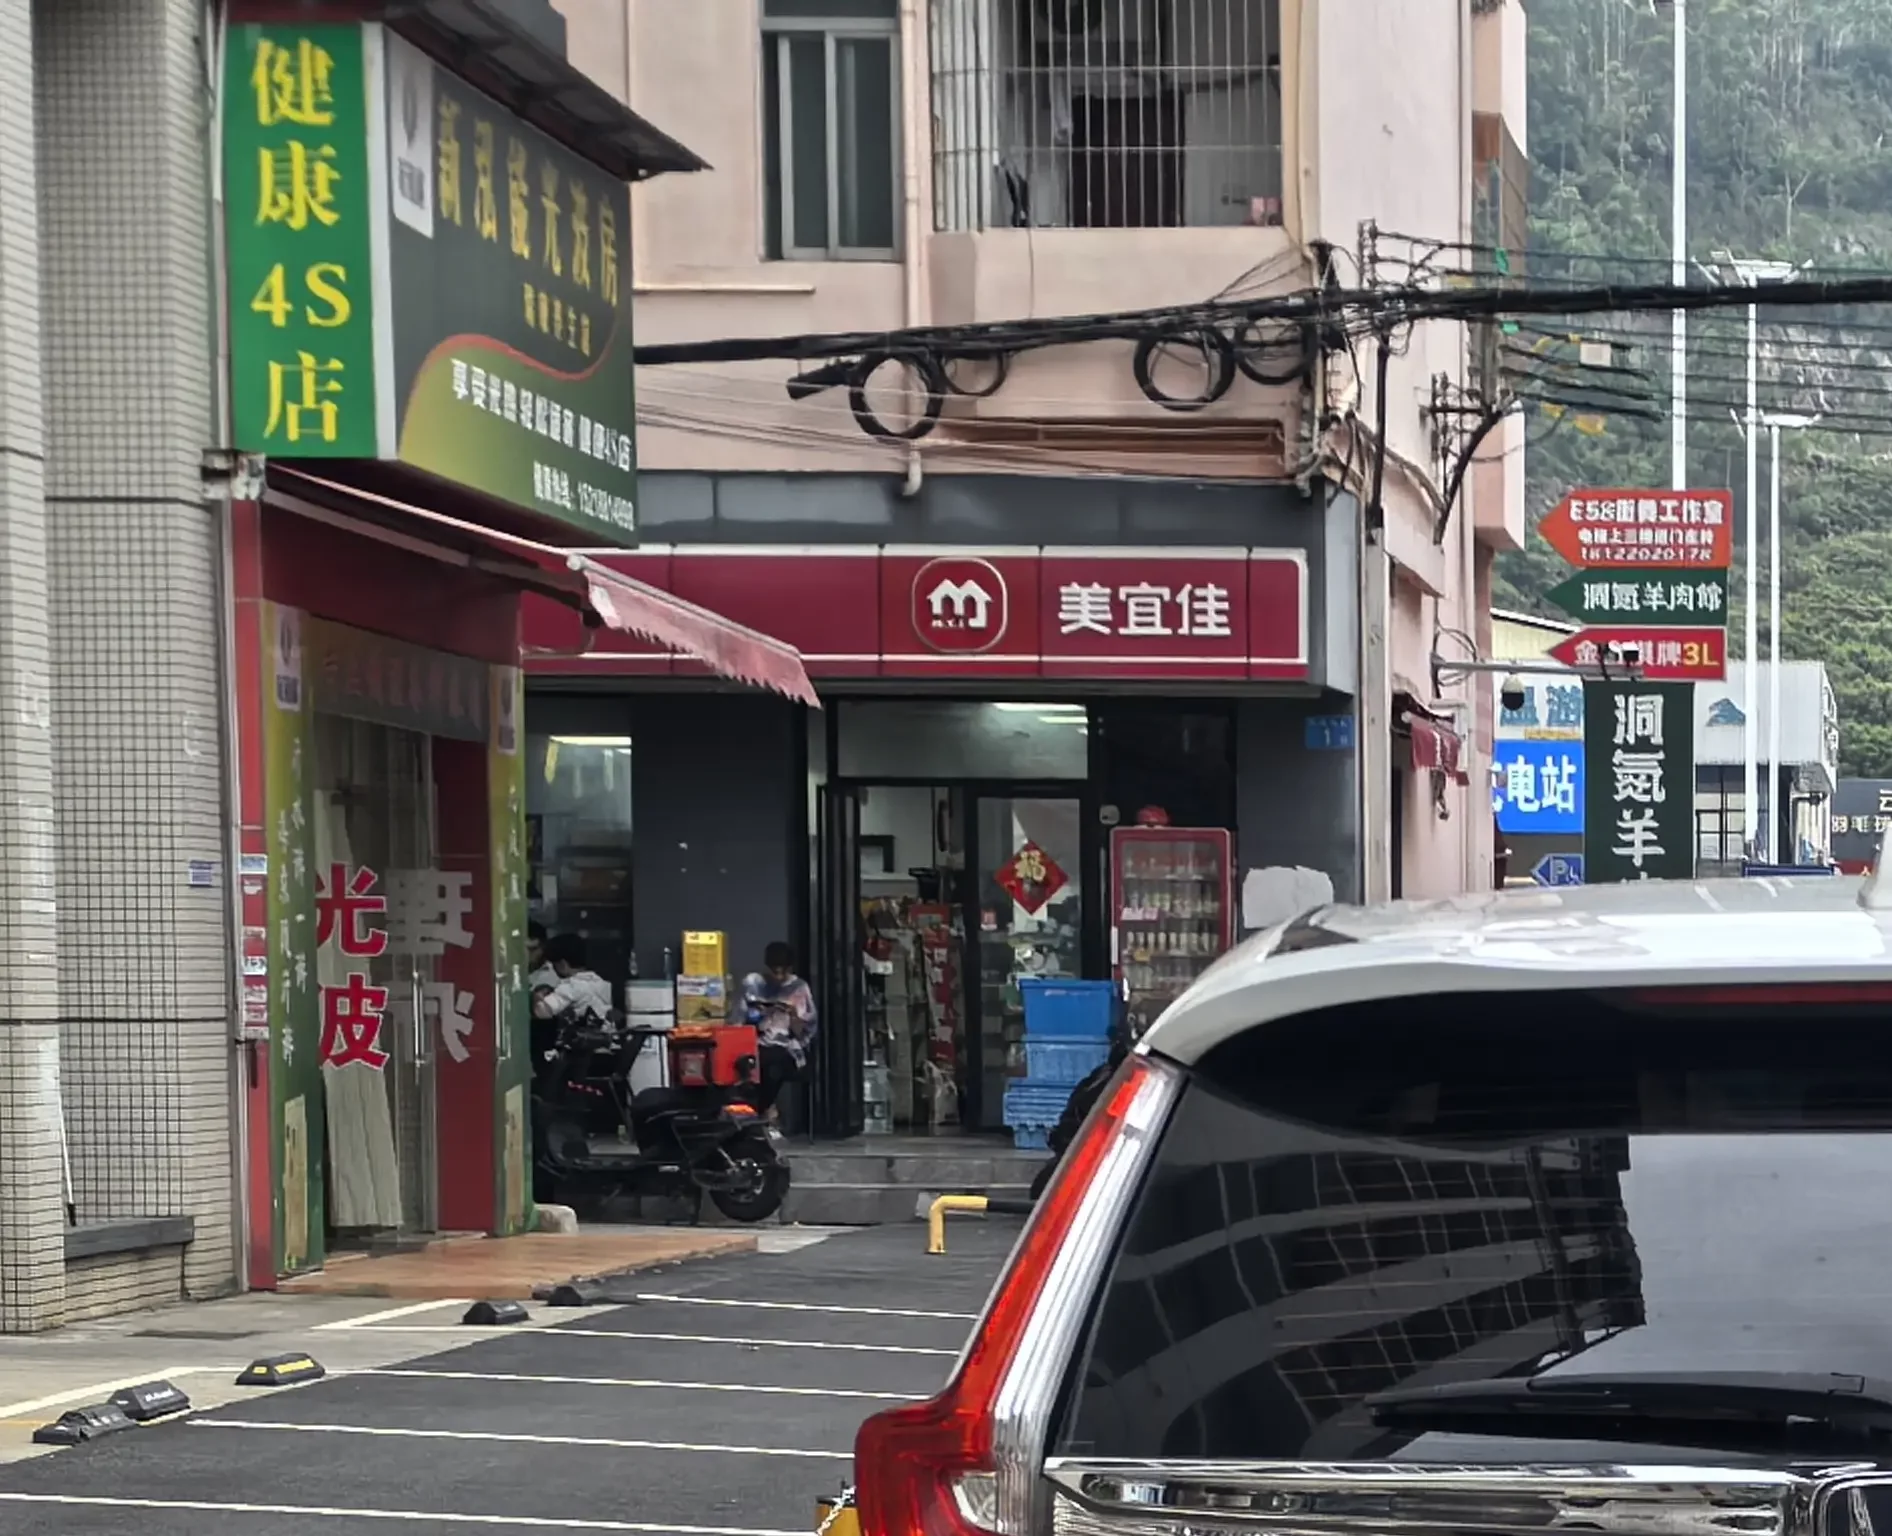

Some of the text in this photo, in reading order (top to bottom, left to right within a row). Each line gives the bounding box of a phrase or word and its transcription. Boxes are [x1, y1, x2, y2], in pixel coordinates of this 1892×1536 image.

[250, 37, 352, 443] 健康4S店
[1058, 580, 1232, 637] 美宜佳
